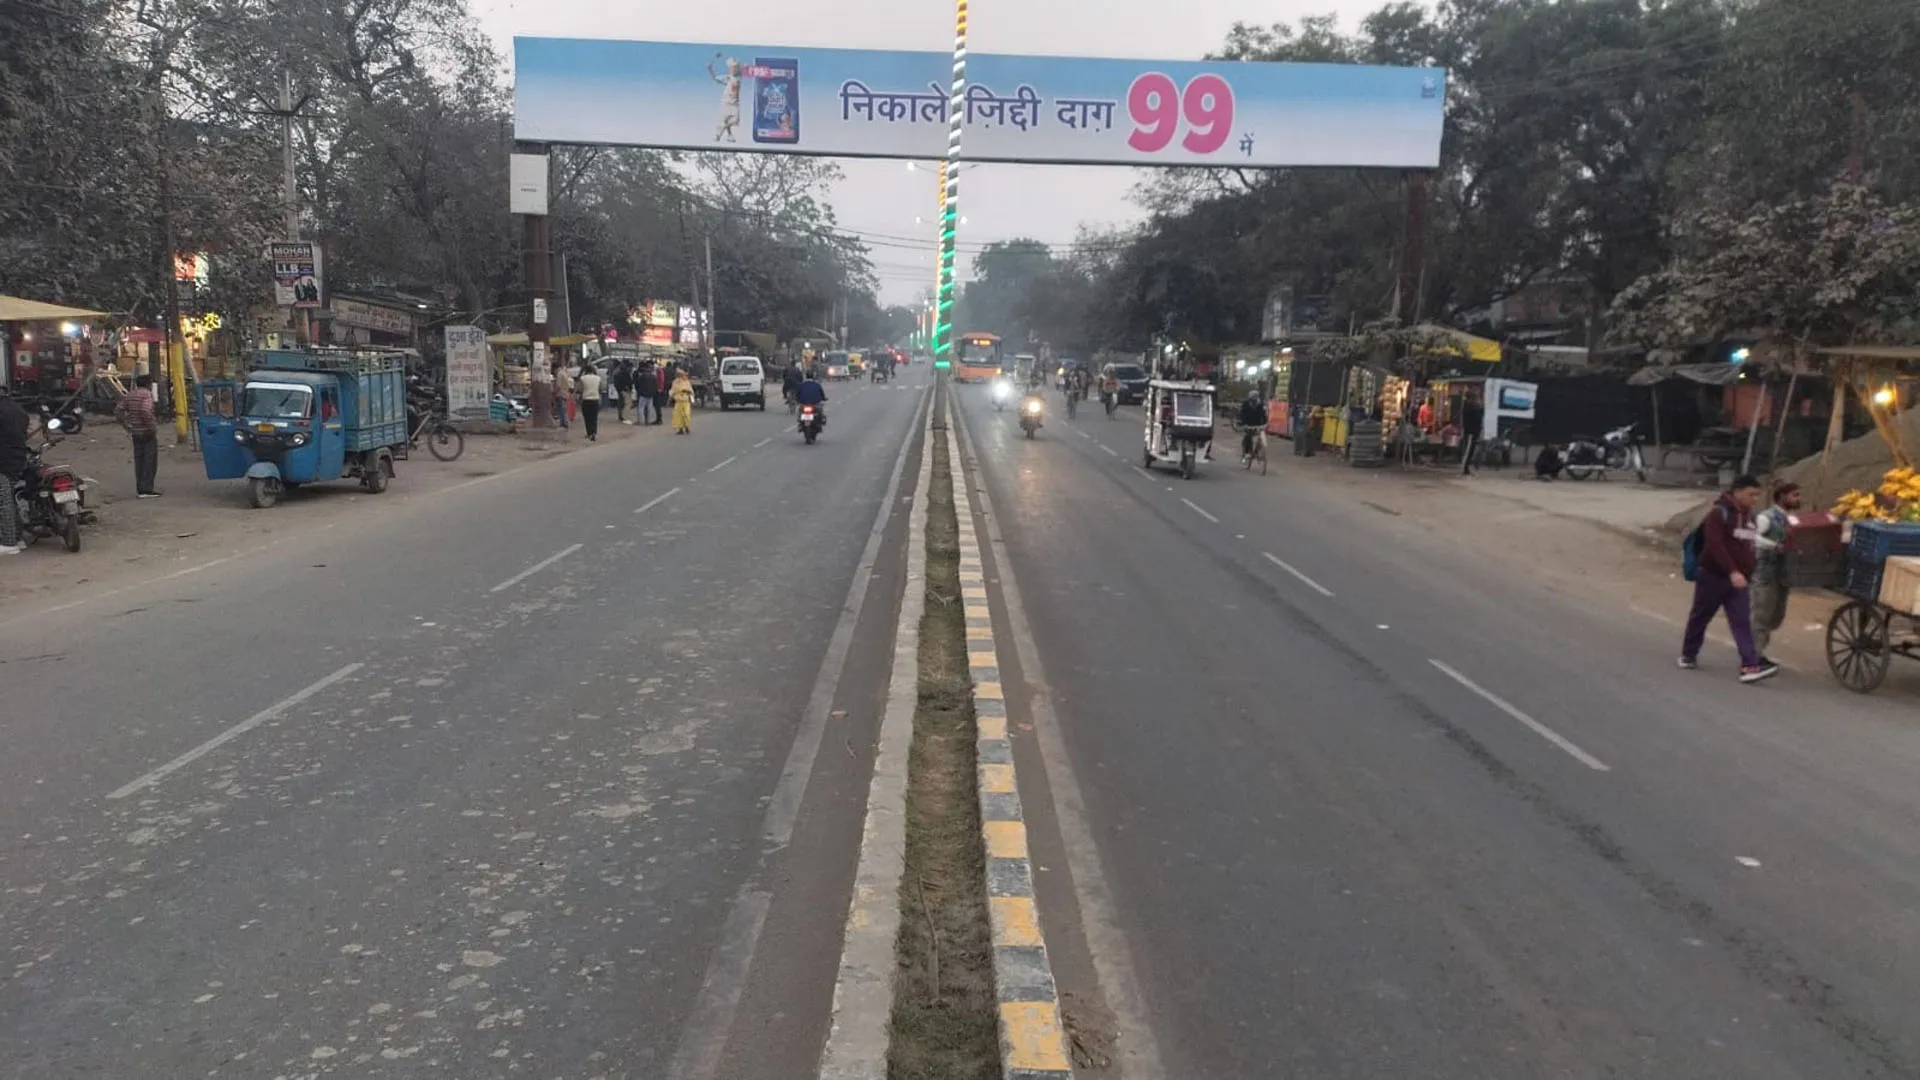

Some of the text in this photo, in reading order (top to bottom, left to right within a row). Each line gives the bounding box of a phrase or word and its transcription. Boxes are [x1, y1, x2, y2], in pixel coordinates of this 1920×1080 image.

[840, 81, 949, 123] निकाले
[1127, 73, 1234, 154] 99
[1239, 132, 1254, 157] में
[275, 263, 299, 274] LLB
